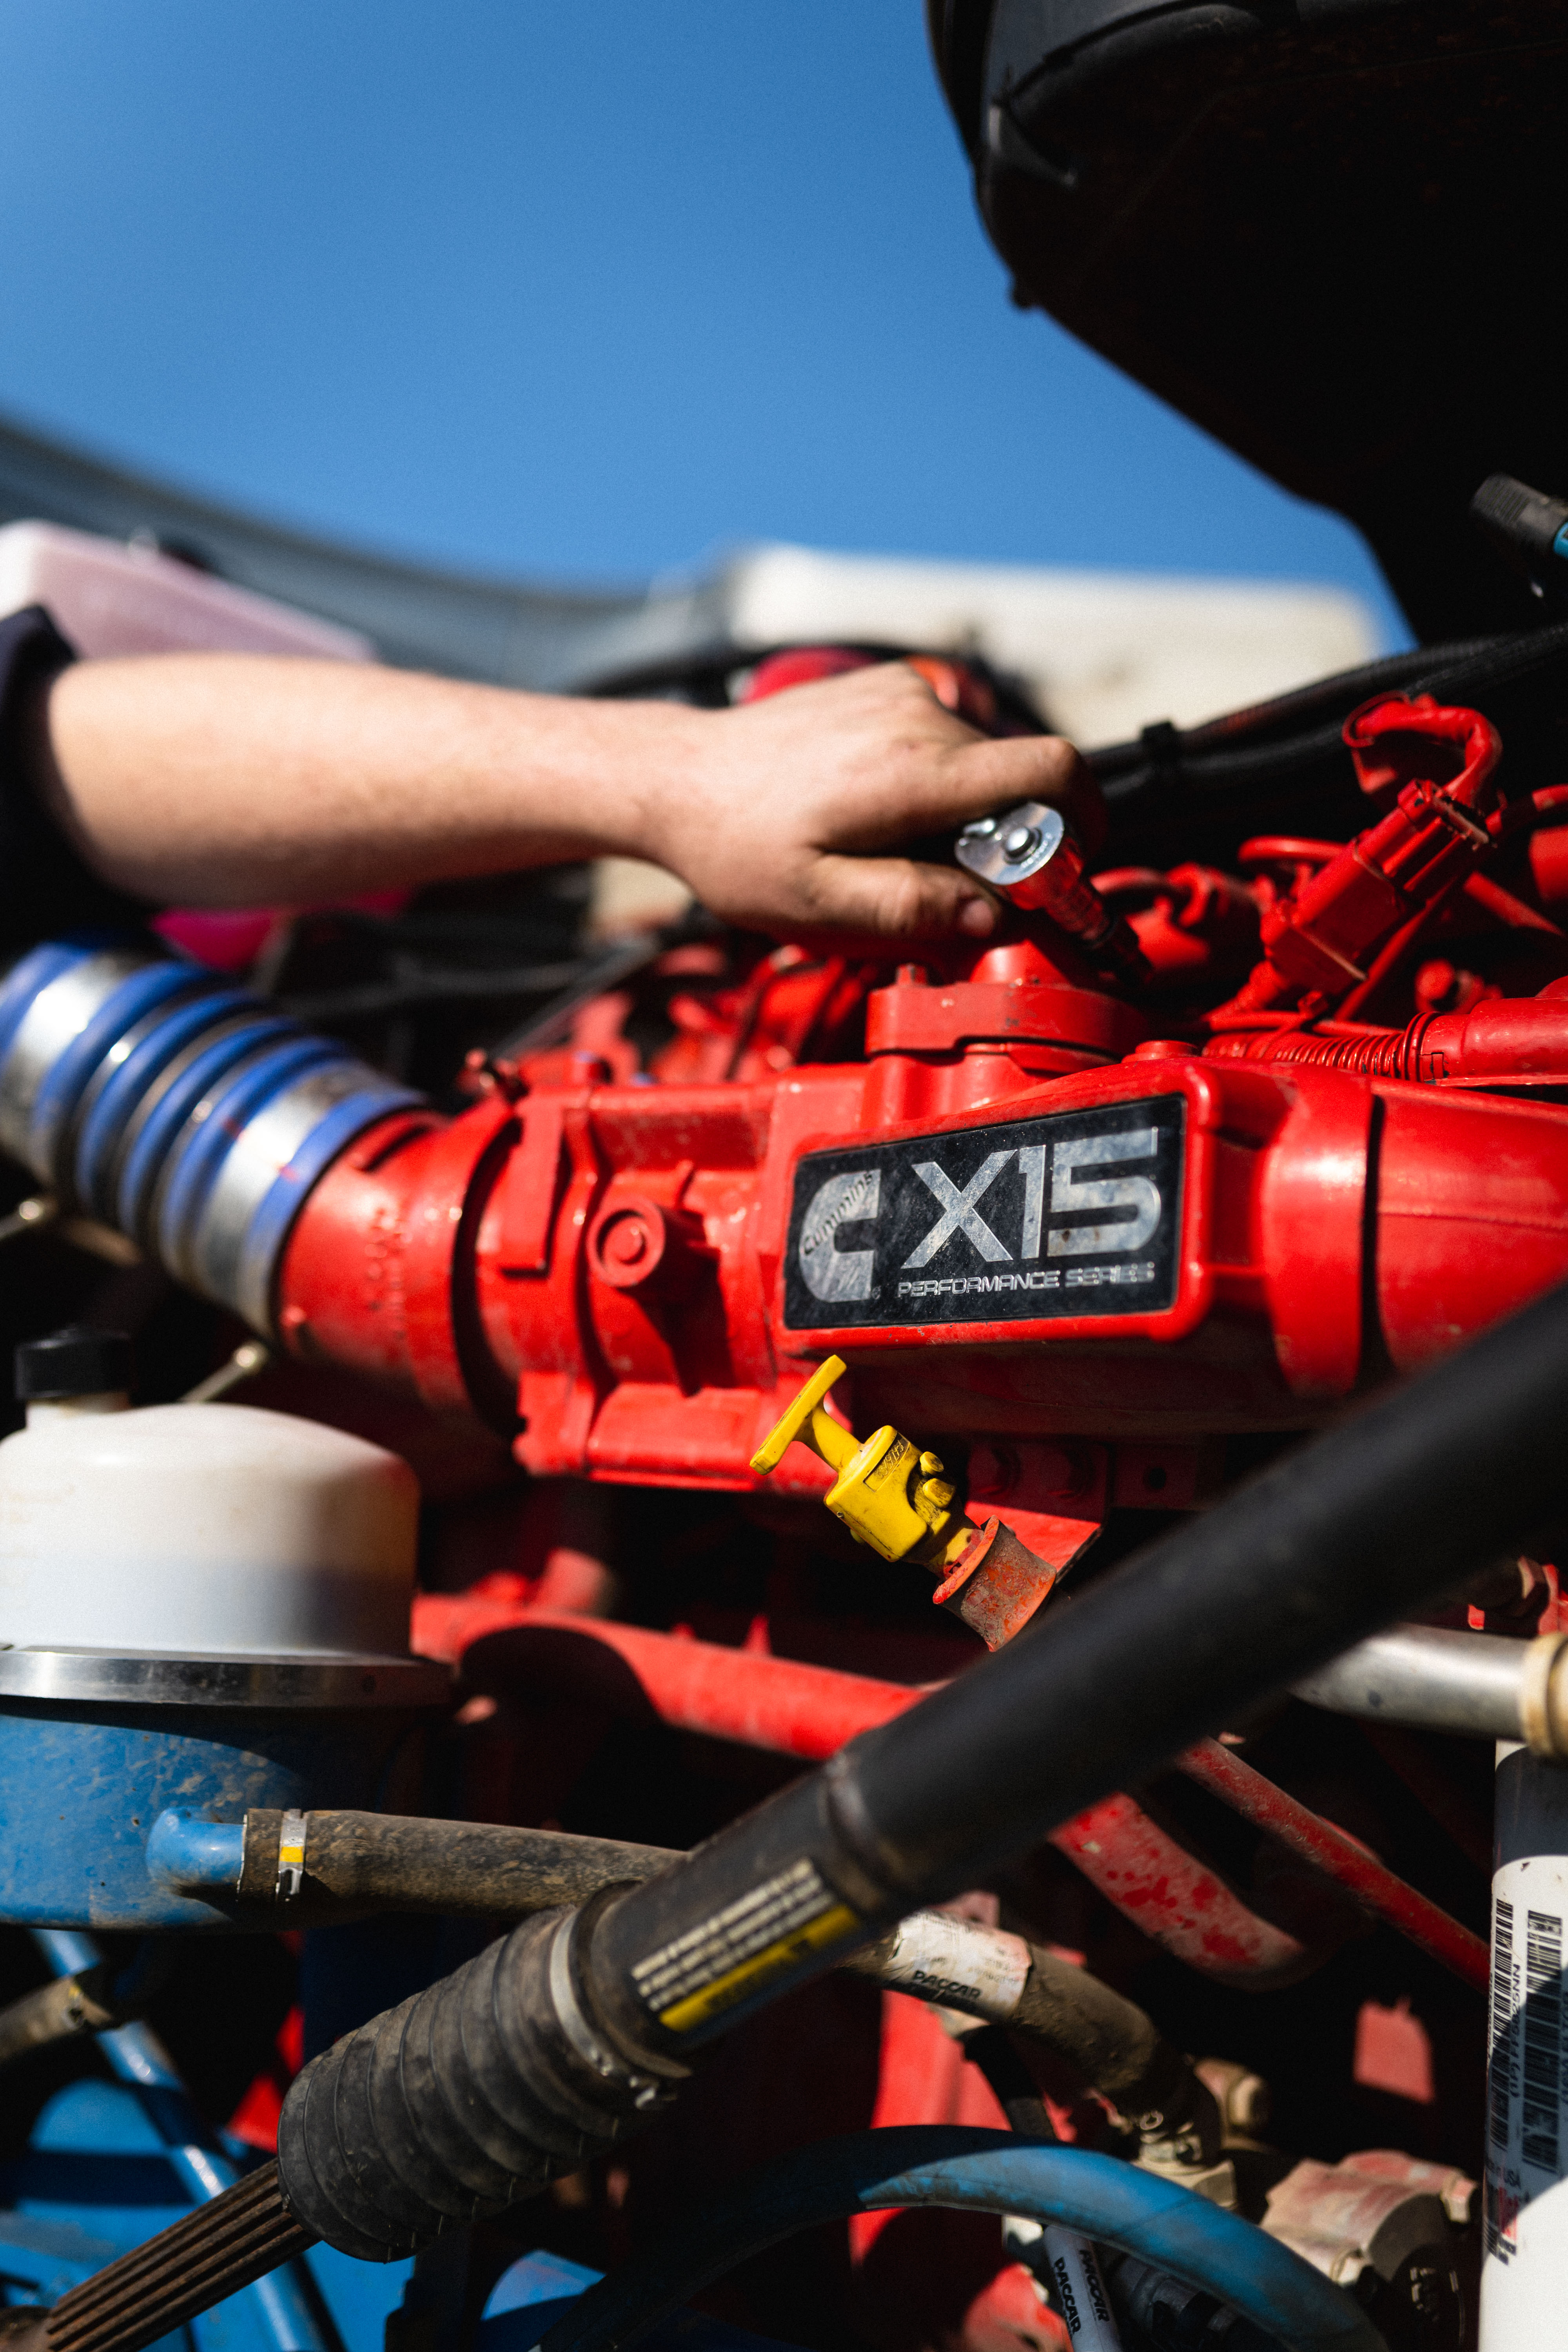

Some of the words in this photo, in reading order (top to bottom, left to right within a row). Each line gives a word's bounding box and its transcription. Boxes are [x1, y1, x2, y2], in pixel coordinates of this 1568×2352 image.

[804, 1173, 873, 1256] Cummins
[901, 1127, 1161, 1269] X15
[898, 1270, 1060, 1298] PERFORMANCE
[1065, 1261, 1155, 1287] SERIES
[912, 1969, 982, 1999] PACCAR
[1054, 2257, 1081, 2333] PACCAR
